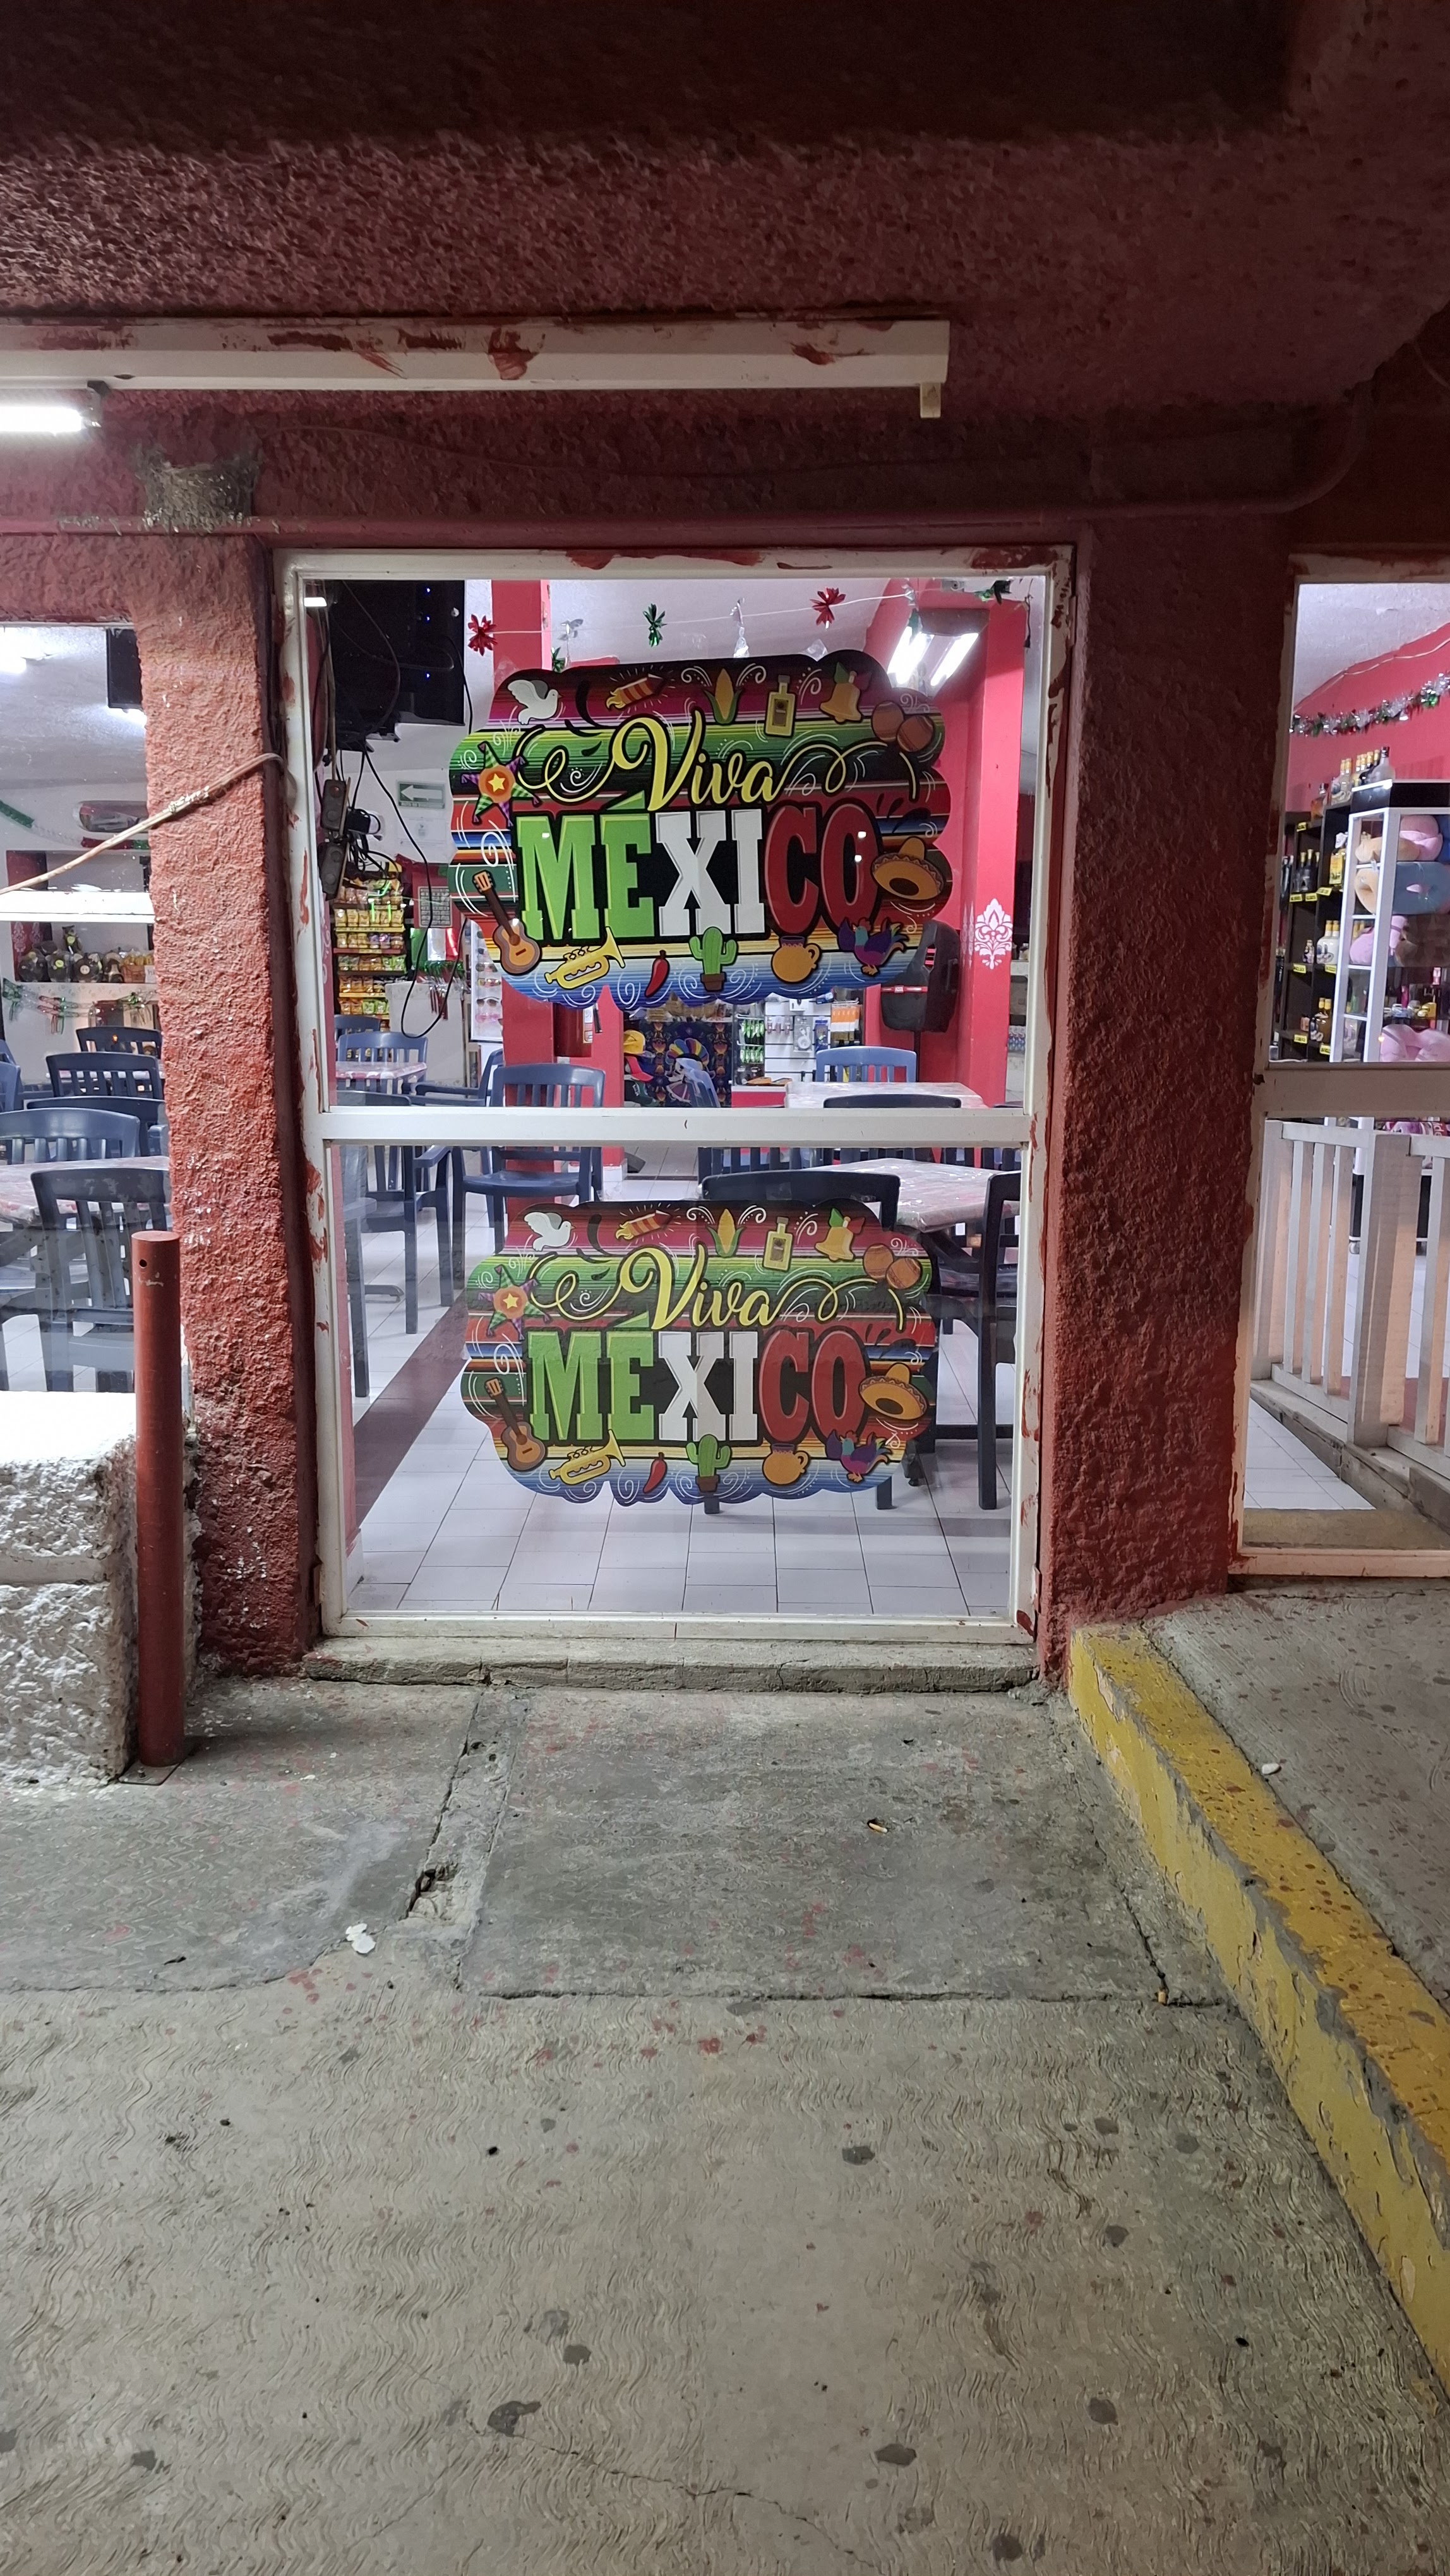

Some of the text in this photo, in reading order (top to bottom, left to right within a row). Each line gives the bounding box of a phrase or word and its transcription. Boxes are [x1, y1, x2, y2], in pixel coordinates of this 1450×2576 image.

[610, 709, 783, 812] Viva
[516, 790, 879, 941] MÉXICO
[616, 1241, 781, 1330] Viva
[527, 1310, 869, 1441] MÉXICO
